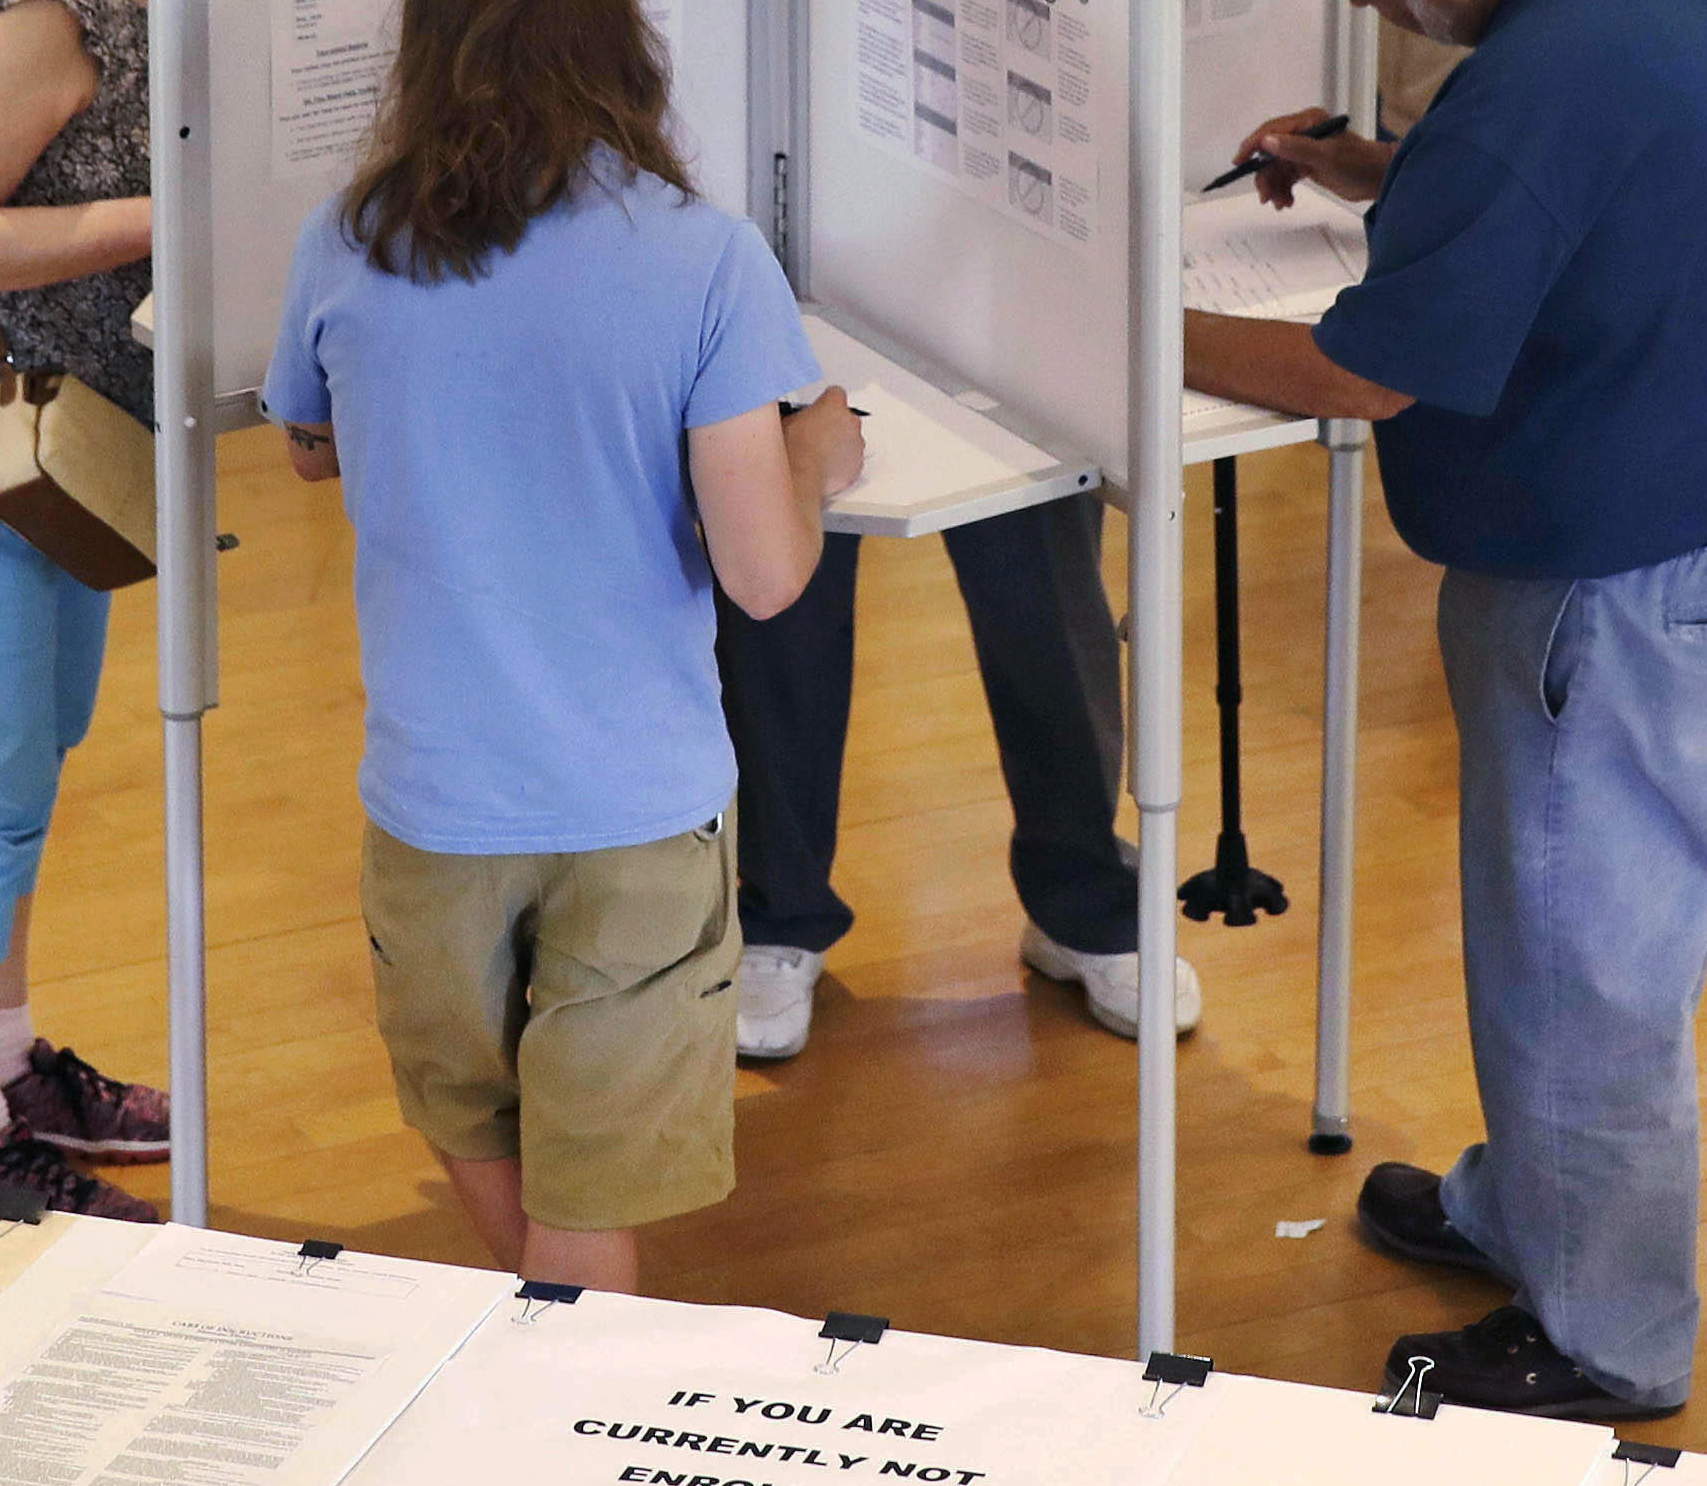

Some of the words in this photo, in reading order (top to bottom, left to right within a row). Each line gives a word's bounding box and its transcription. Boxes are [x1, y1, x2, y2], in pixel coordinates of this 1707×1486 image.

[666, 1390, 716, 1407] IF
[733, 1396, 832, 1426] YOU
[841, 1413, 945, 1442] ARE
[571, 1419, 869, 1471] CURRENTLY
[878, 1459, 986, 1486] NOT
